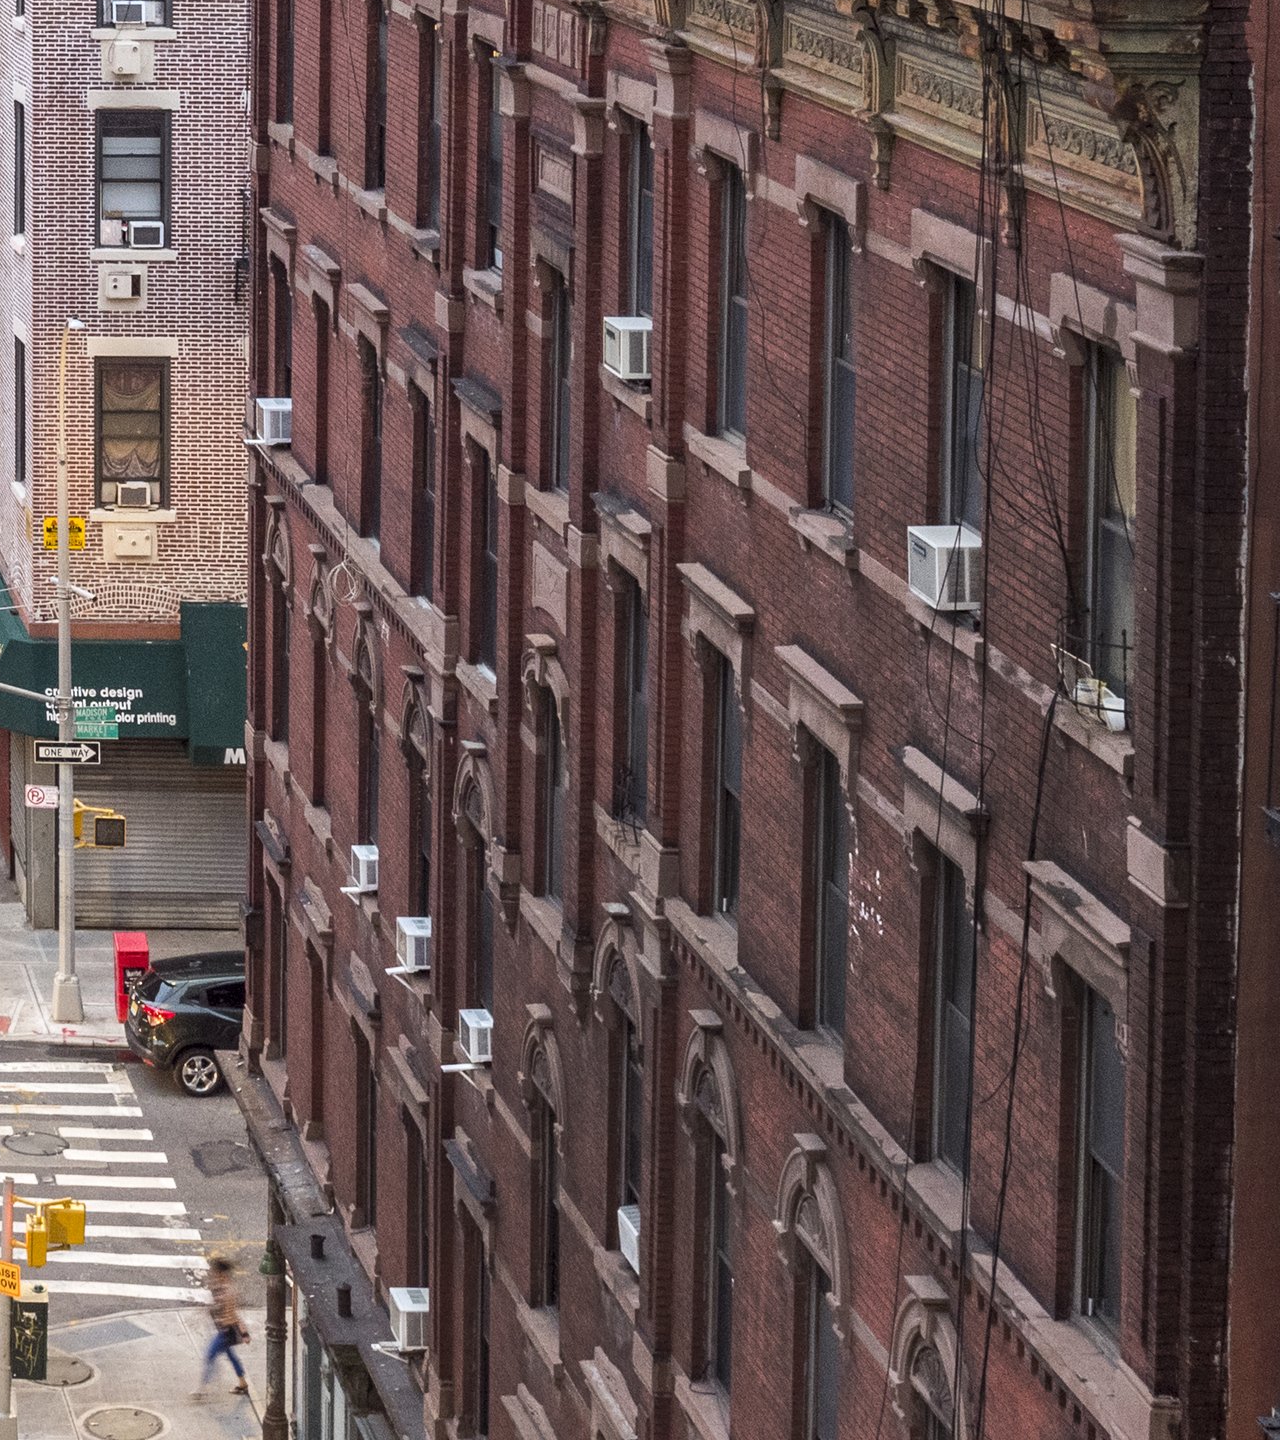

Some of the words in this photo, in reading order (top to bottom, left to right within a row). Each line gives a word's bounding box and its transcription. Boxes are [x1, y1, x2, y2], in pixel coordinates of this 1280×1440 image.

[100, 686, 143, 700] design
[76, 708, 107, 717] MADISON
[137, 712, 176, 726] printing
[77, 725, 107, 733] MARKET
[44, 748, 62, 757] ONE
[71, 748, 89, 757] WAY
